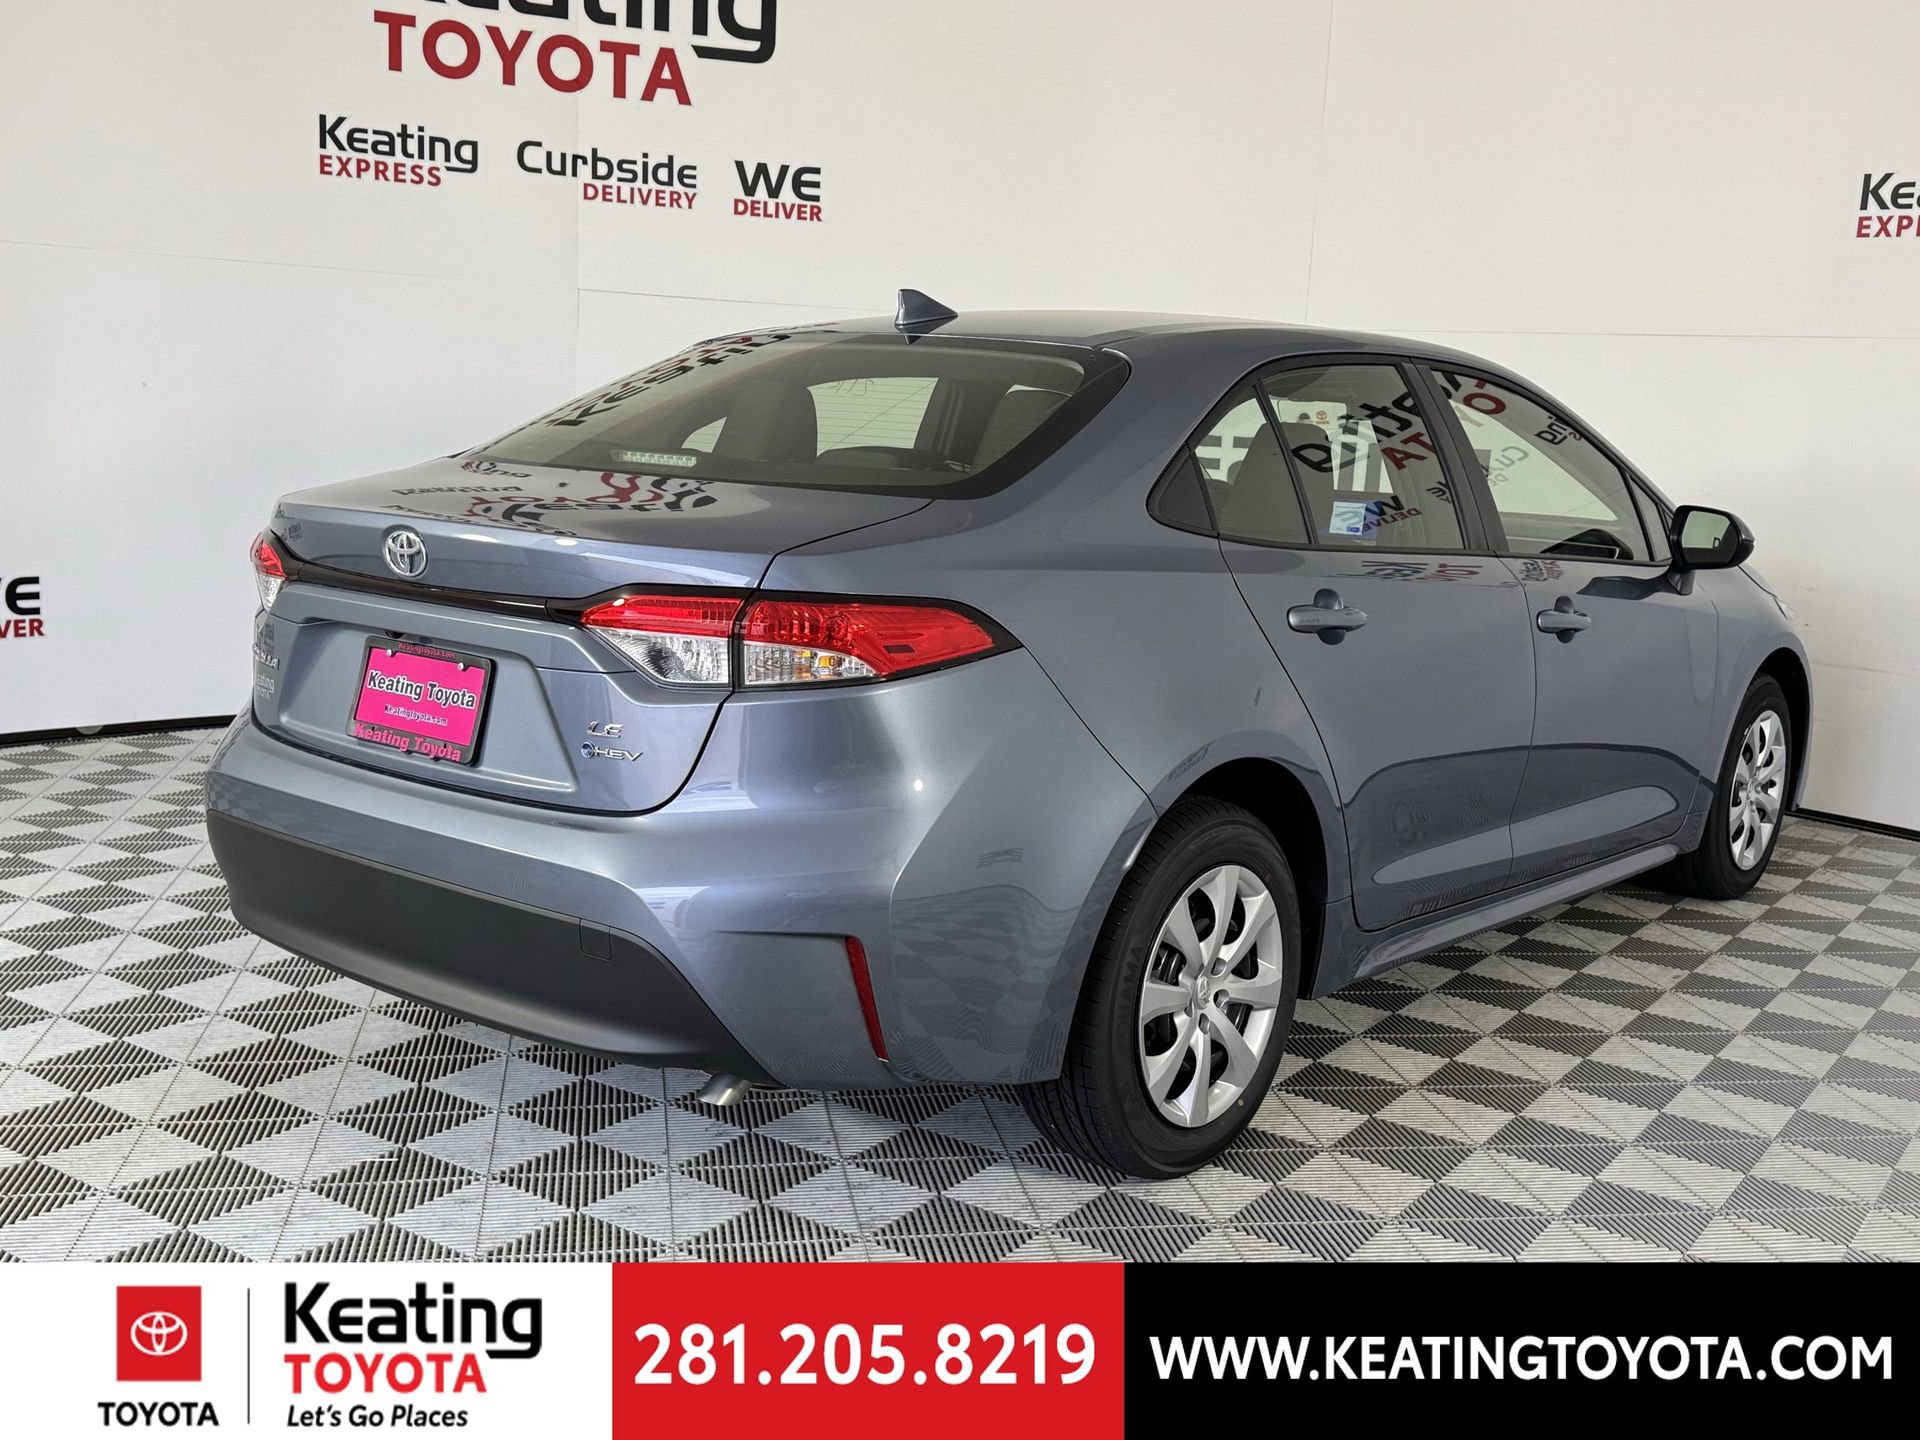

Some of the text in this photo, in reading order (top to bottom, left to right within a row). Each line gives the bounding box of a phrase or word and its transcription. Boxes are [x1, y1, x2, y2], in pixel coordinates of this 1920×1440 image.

[374, 10, 692, 105] TOYOTA
[319, 114, 478, 173] Keating
[319, 155, 441, 186] EXPRESS
[517, 141, 697, 189] Curbside
[734, 160, 821, 204] WE
[583, 183, 697, 209] DELIVERY
[733, 198, 822, 222] DELIVER
[1860, 172, 1920, 210] Ke
[1856, 215, 1920, 238] EXP
[368, 670, 476, 708] Keating Toyota
[354, 723, 461, 761] Keating Toyota
[587, 721, 624, 738] LE
[594, 746, 643, 761] HEV
